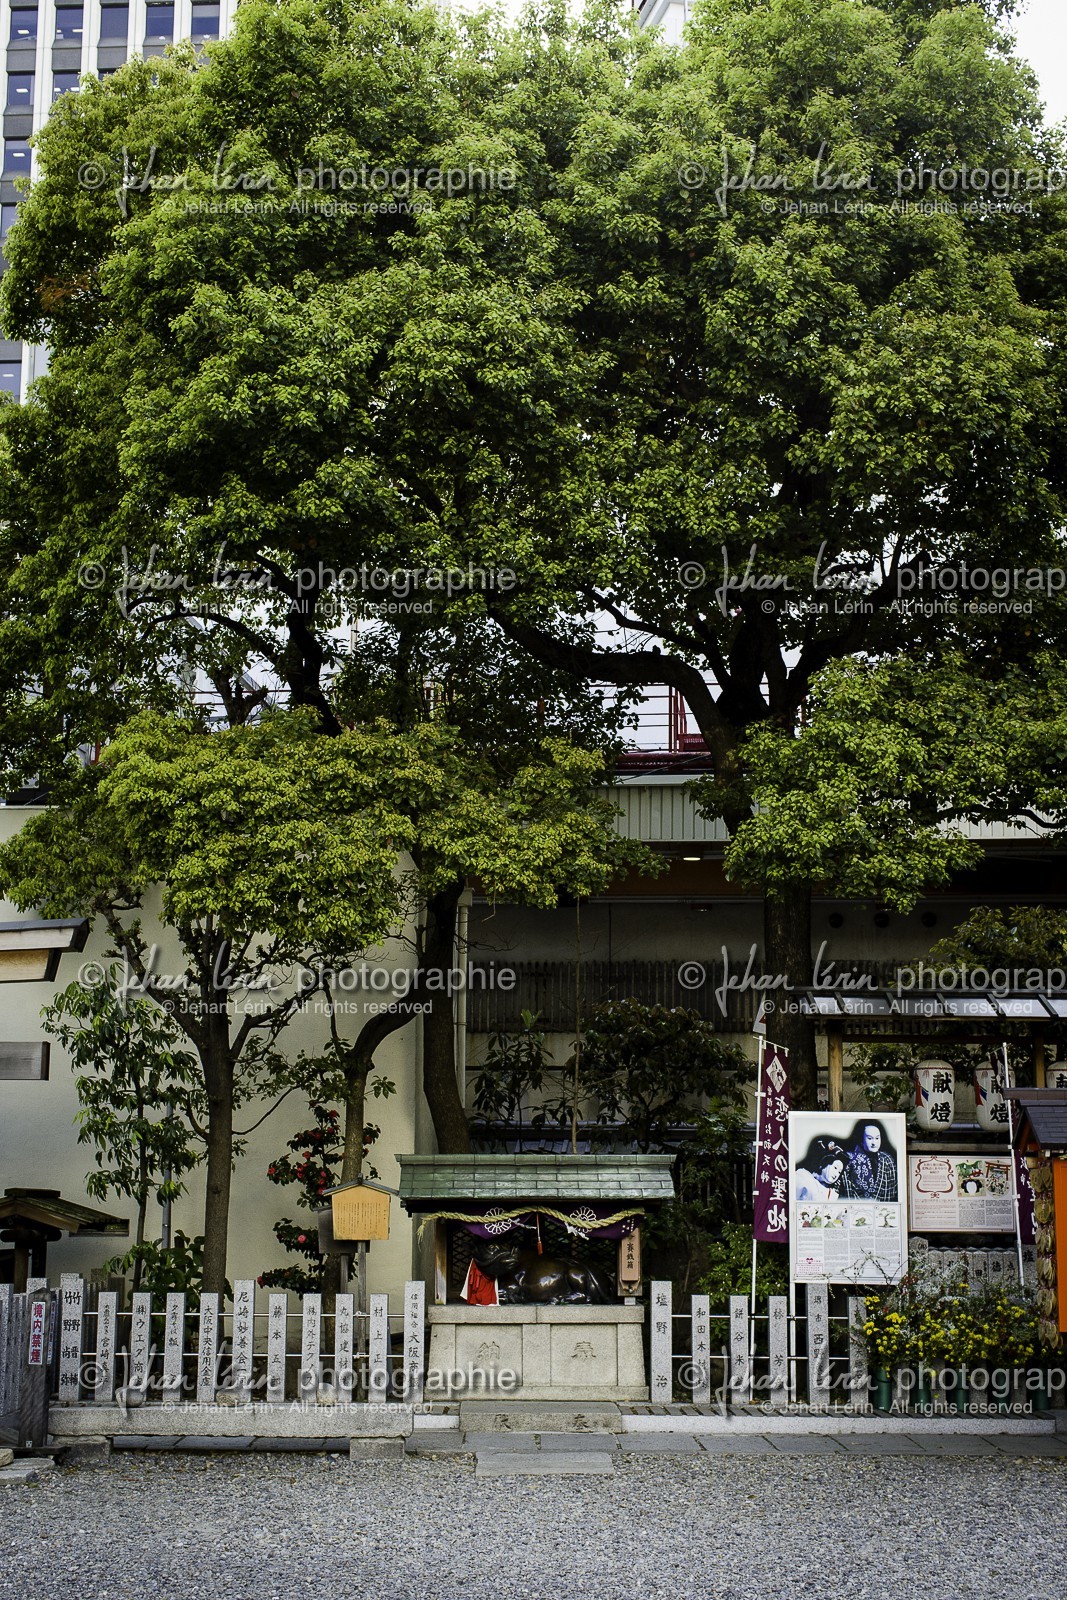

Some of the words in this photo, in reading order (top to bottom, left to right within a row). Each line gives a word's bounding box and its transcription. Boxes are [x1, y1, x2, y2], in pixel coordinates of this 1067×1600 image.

[930, 1070, 953, 1123] 献燈
[30, 1303, 43, 1363] 境内禁煙
[200, 1305, 214, 1387] 大阪中央信用金庫
